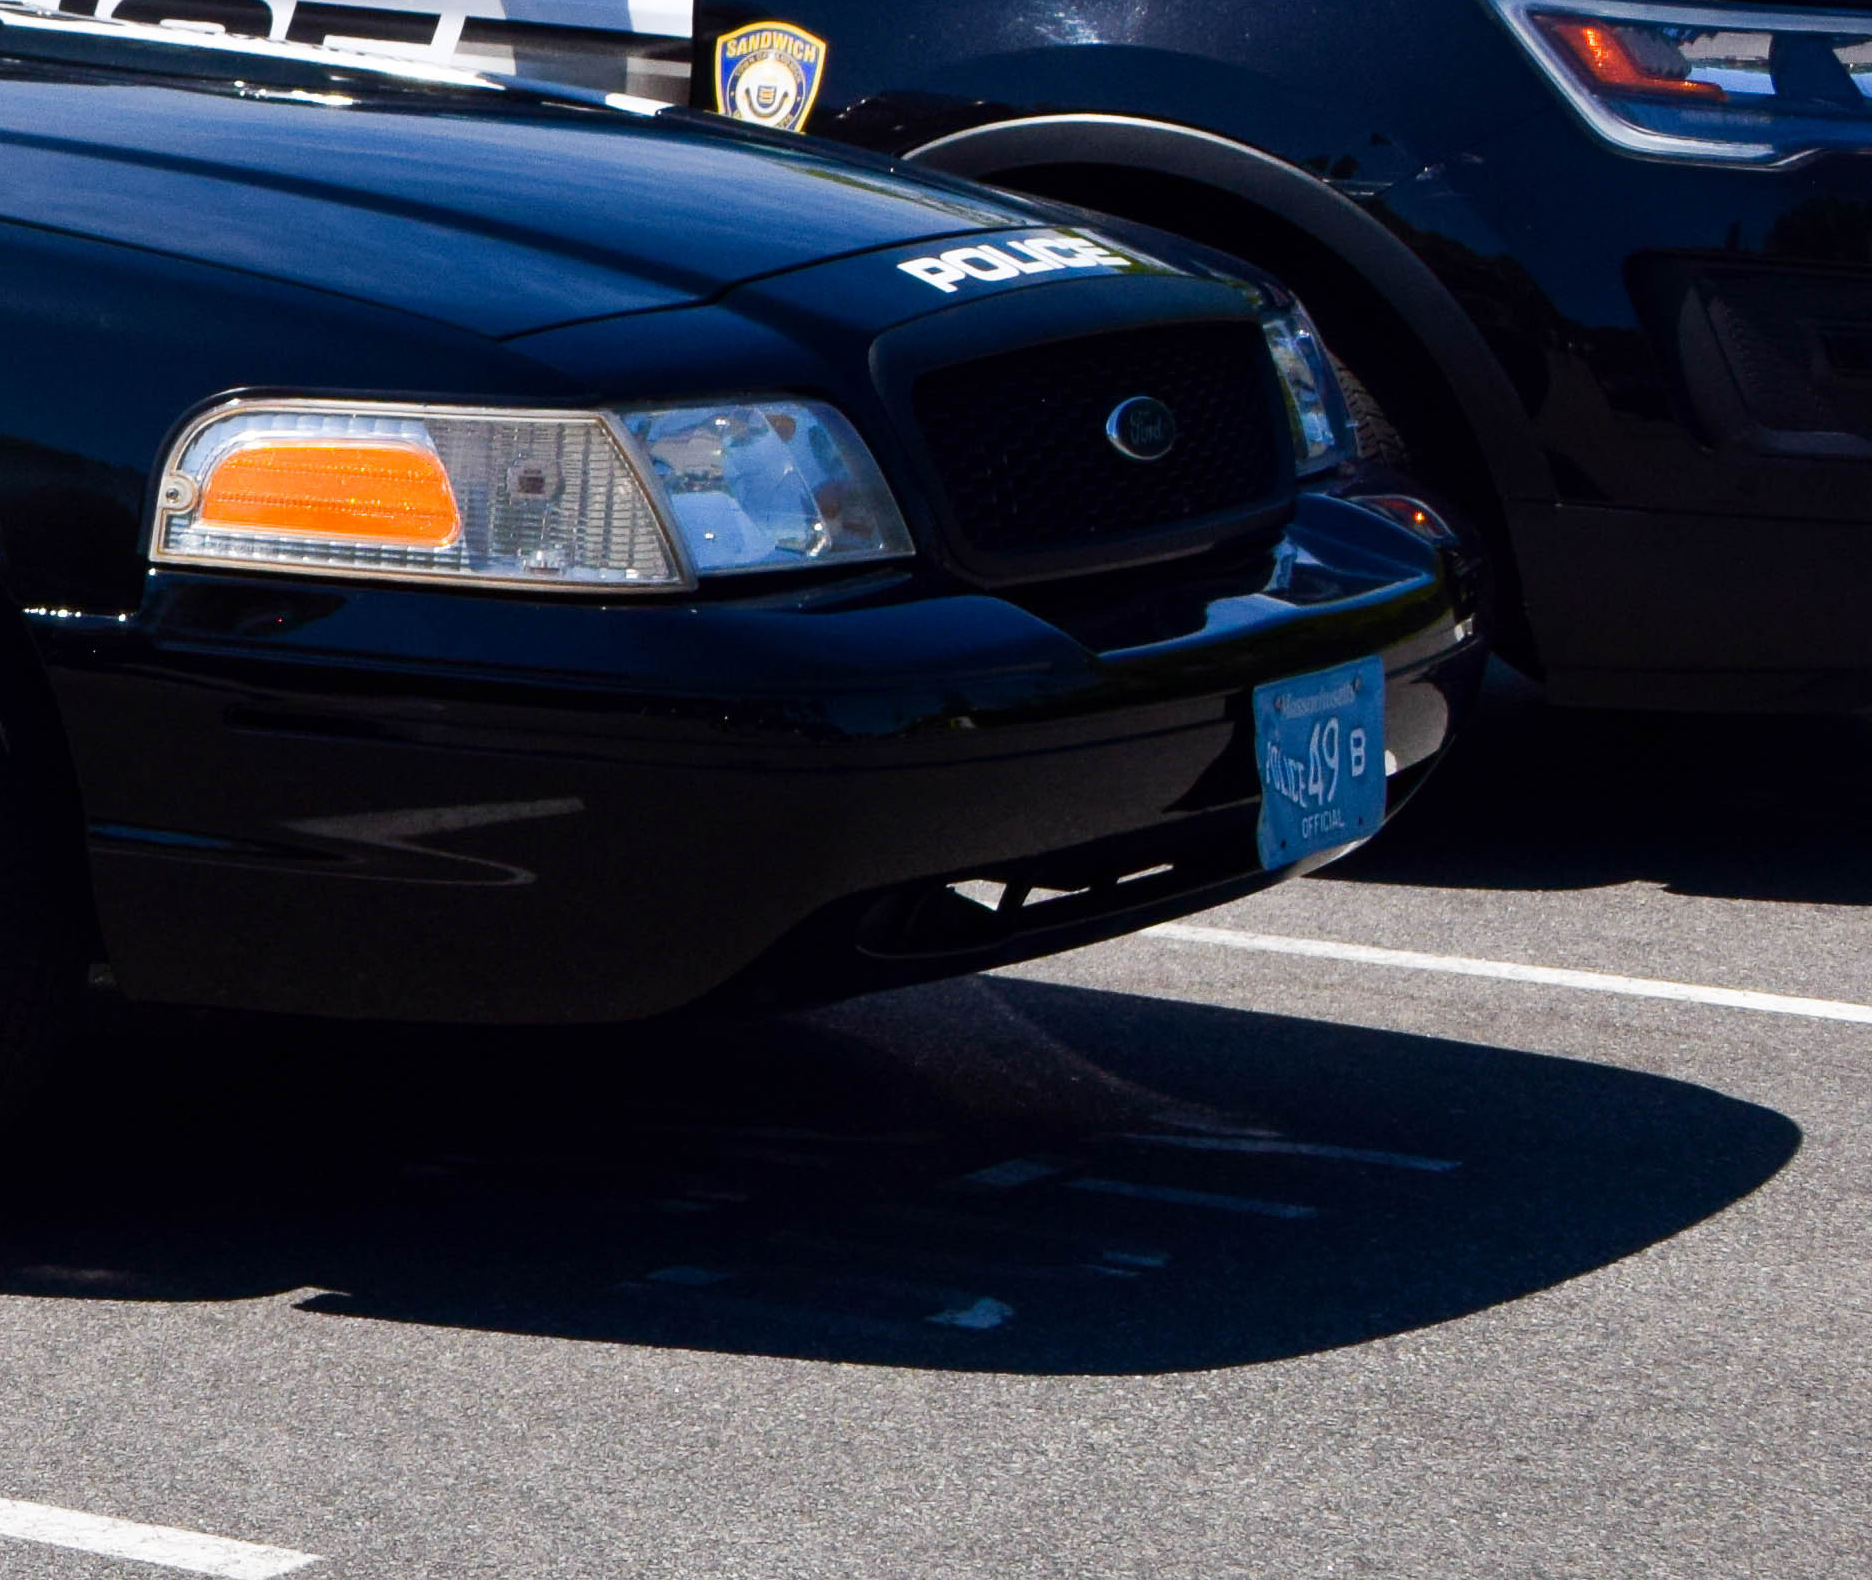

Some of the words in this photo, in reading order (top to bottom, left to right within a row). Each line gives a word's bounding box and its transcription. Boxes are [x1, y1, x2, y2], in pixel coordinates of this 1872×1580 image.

[726, 31, 817, 63] SANDWICH
[896, 237, 1133, 294] POLICE
[1308, 716, 1339, 806] 49
[1350, 727, 1367, 778] B
[1301, 807, 1346, 839] OFFICIAL
